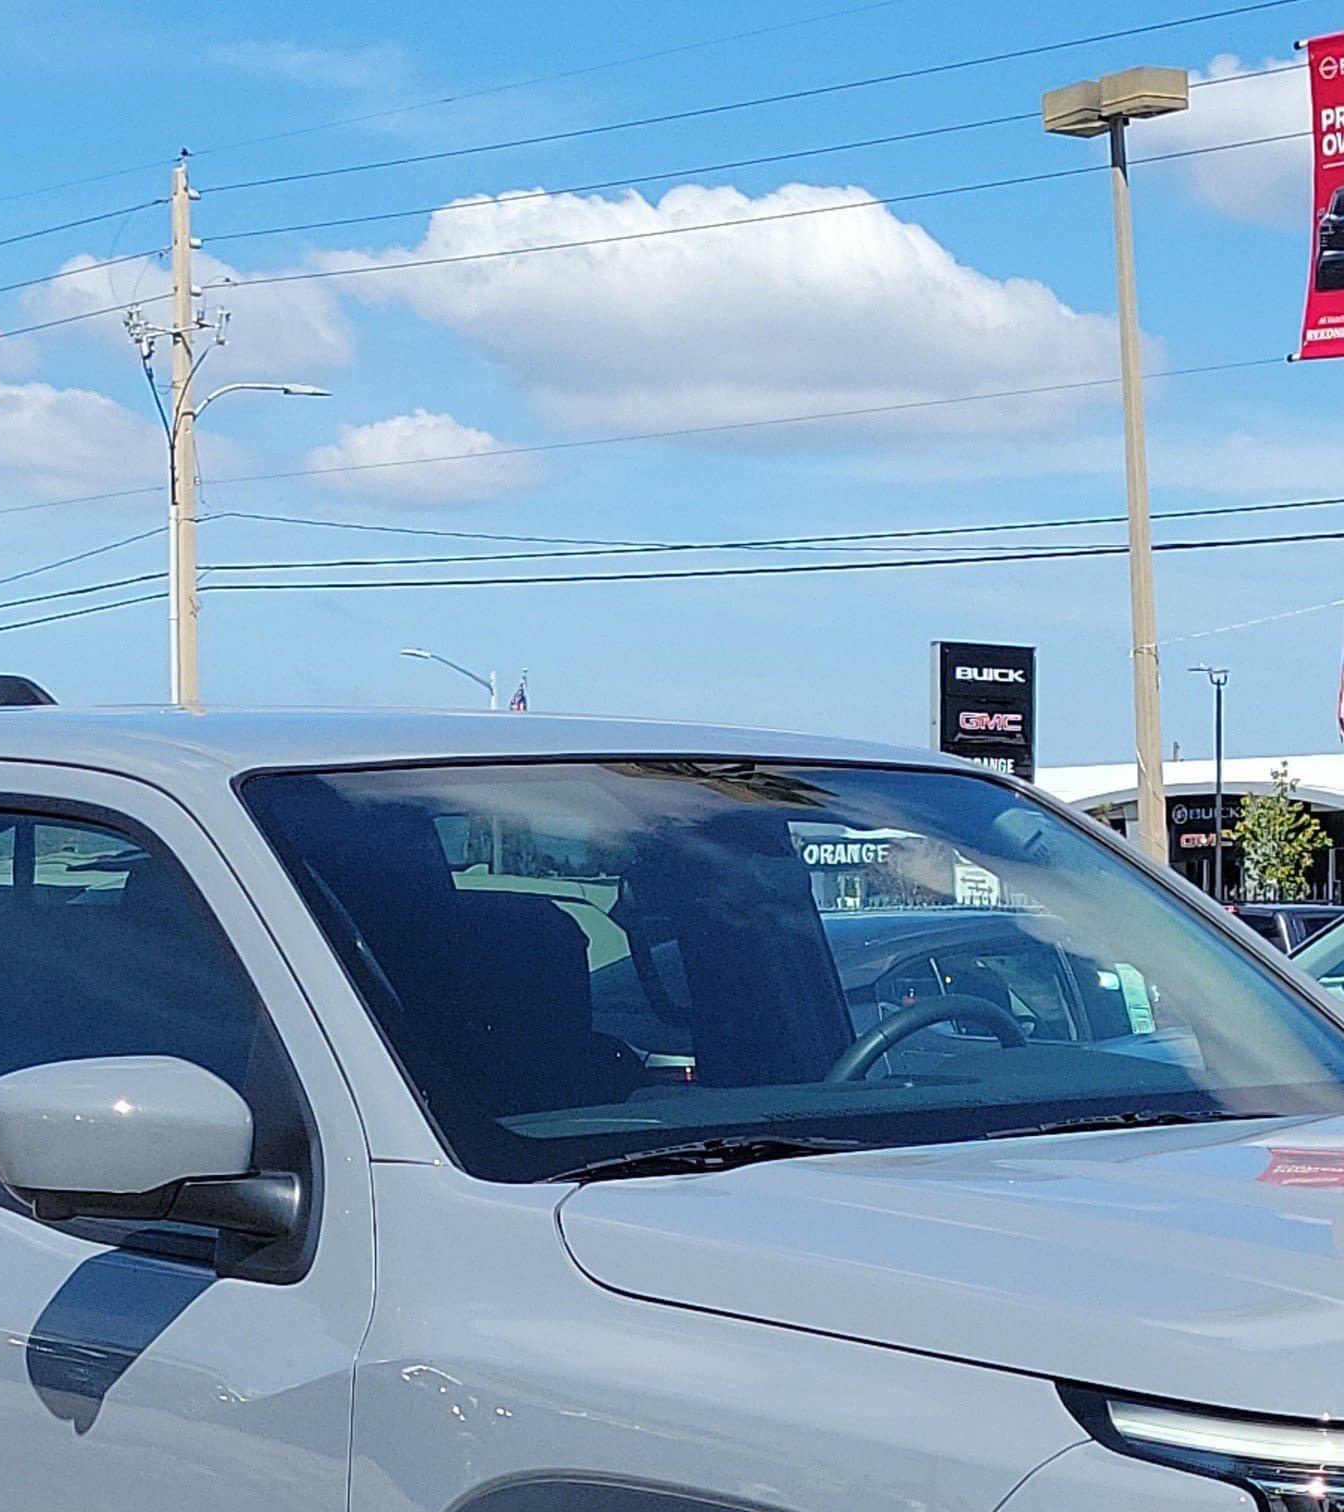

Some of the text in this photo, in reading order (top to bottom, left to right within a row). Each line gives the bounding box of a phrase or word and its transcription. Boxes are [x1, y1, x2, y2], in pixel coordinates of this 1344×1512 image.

[954, 665, 1027, 684] BUICK
[958, 710, 1023, 732] GMC
[802, 842, 891, 866] ORANGE
